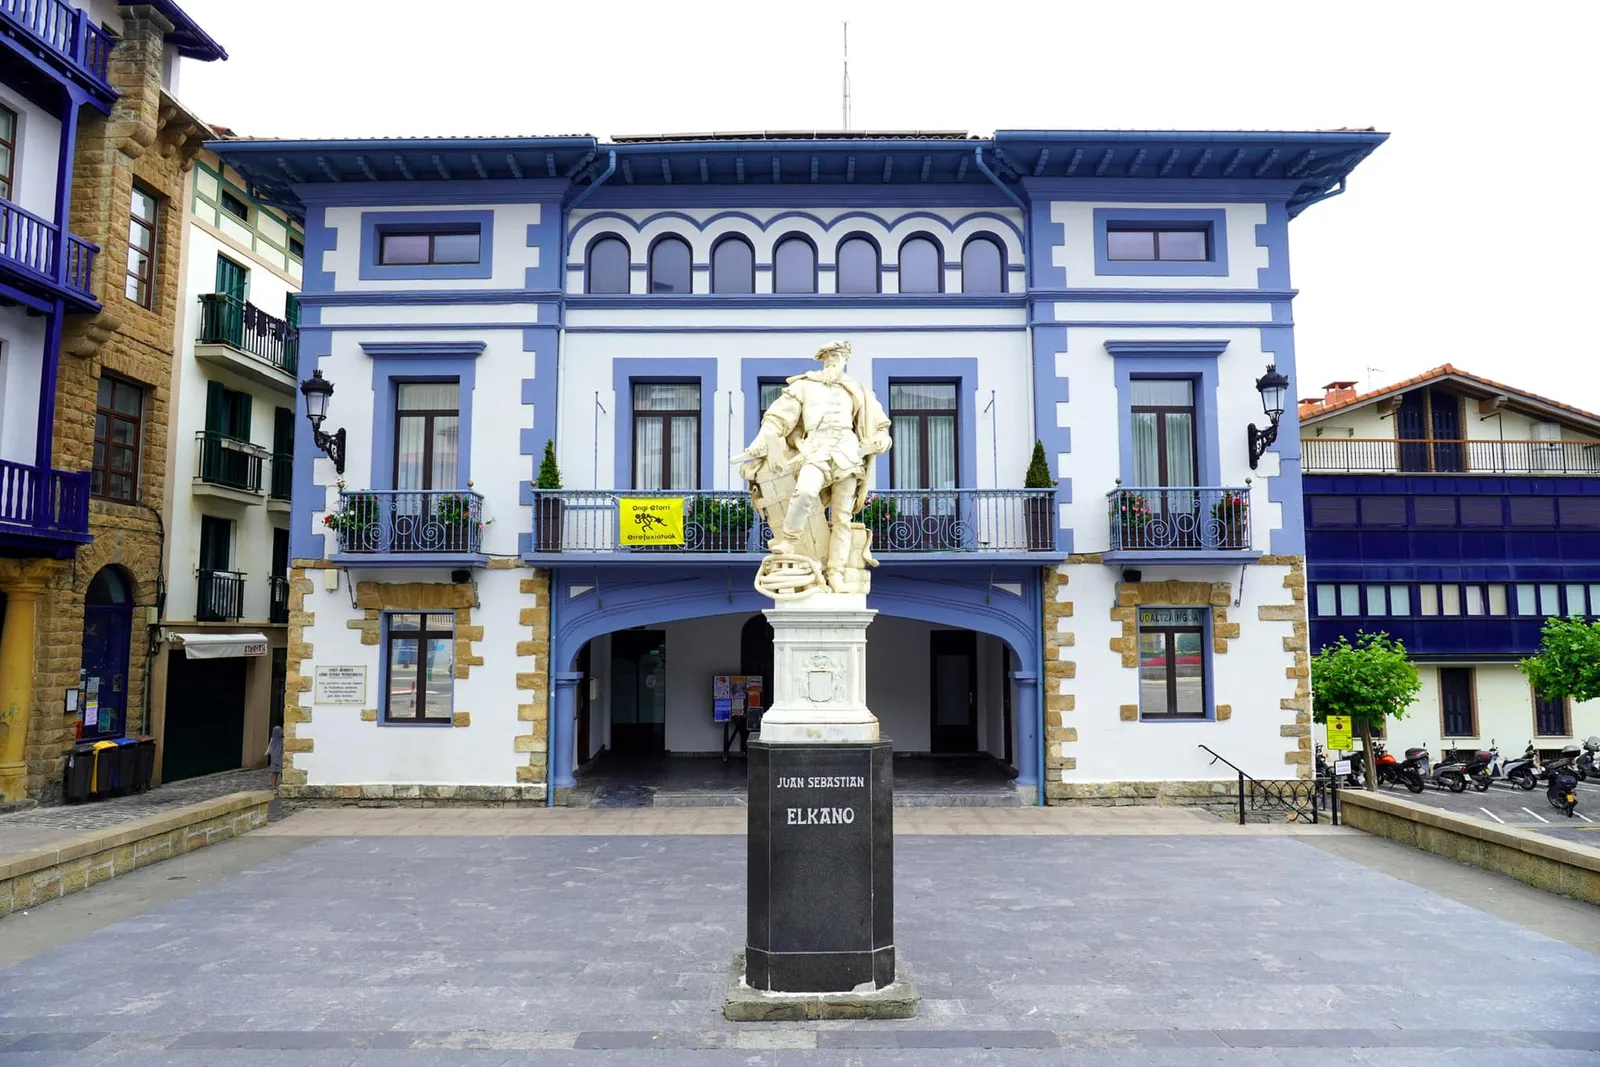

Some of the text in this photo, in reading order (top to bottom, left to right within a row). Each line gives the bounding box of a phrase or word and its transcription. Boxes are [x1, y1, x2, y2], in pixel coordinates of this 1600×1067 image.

[627, 533, 676, 541] errefuxiatuak
[776, 776, 865, 788] JUAN SEBASTIAN
[786, 807, 855, 825] ELKANO
